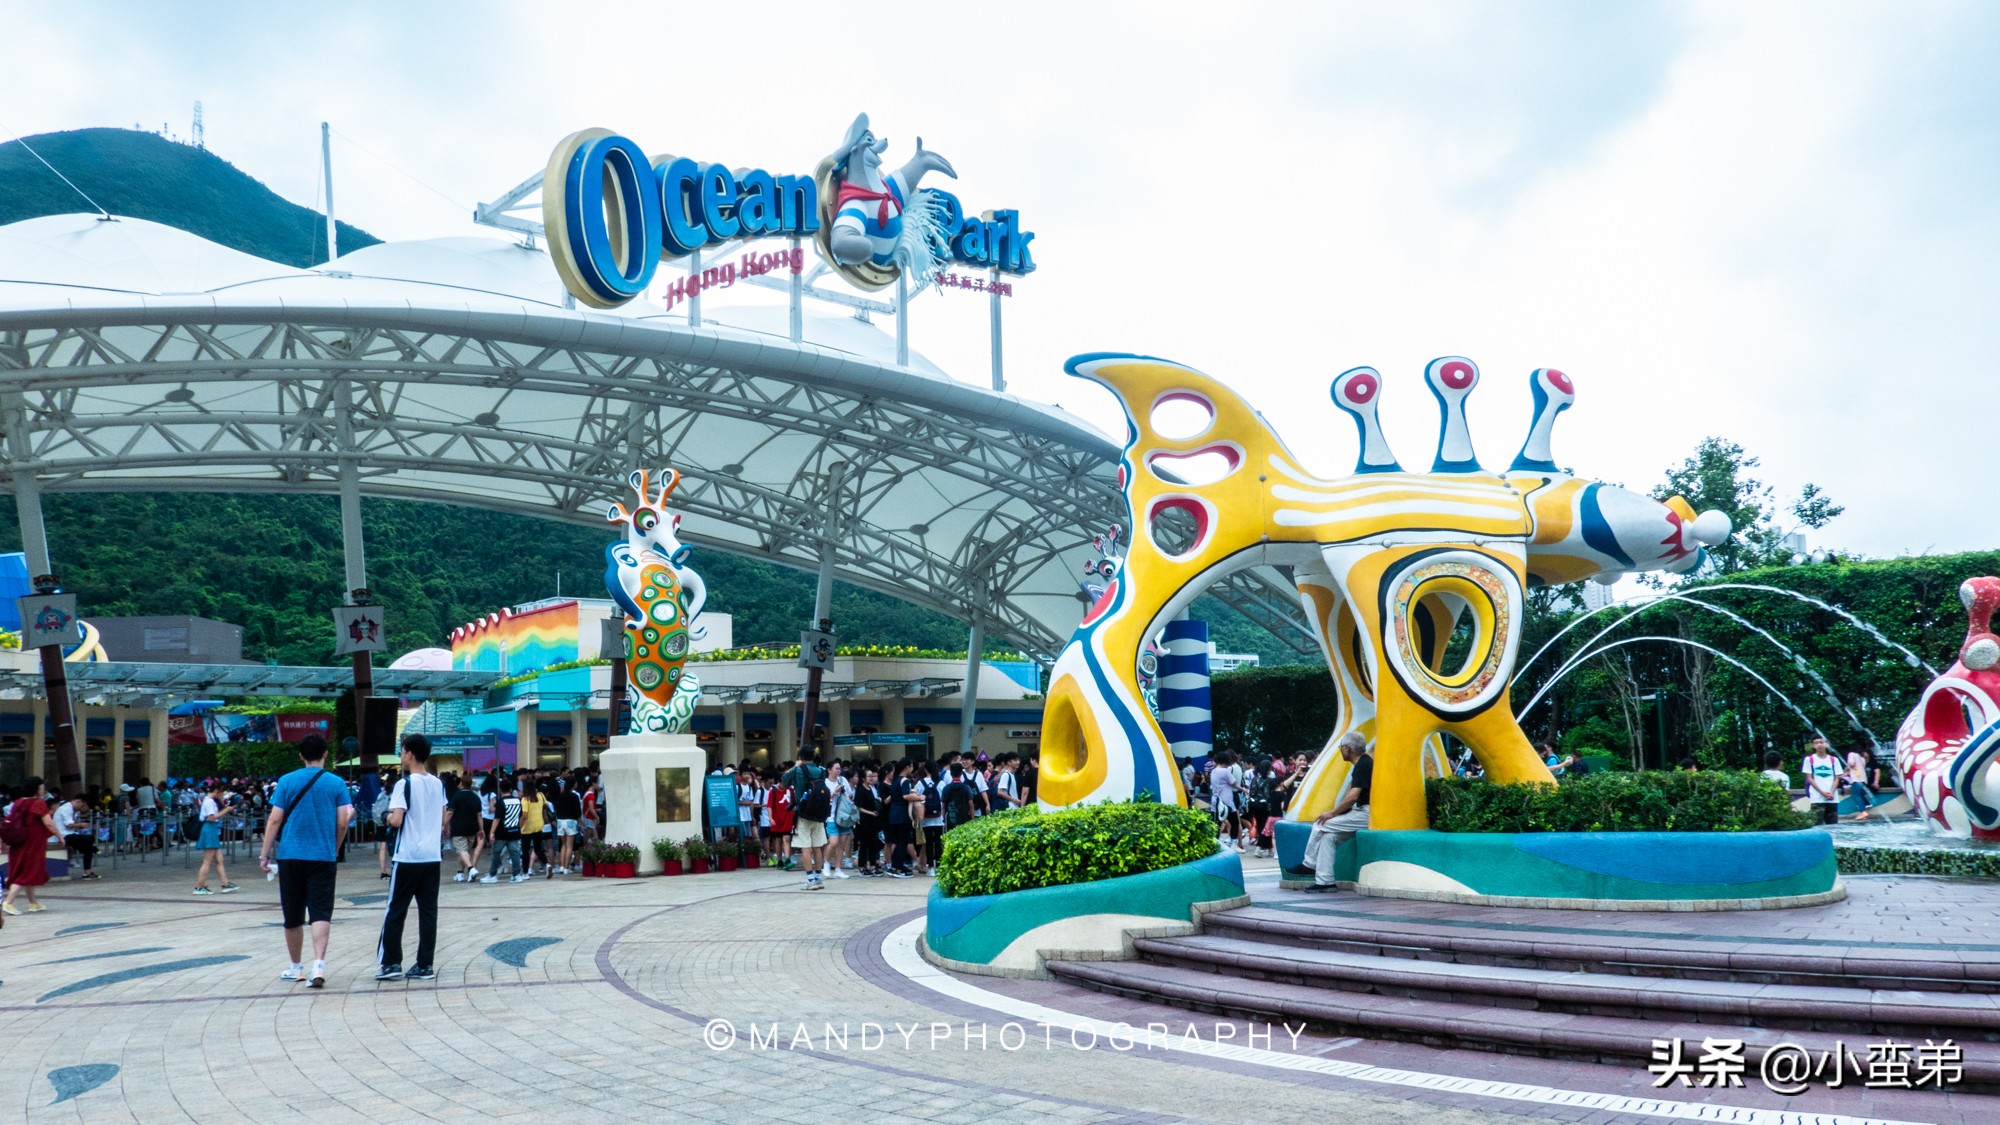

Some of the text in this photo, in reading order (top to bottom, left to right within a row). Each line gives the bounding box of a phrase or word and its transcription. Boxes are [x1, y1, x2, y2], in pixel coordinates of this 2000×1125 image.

[545, 128, 1036, 307] Ocean Park
[665, 247, 804, 312] Hong Kong
